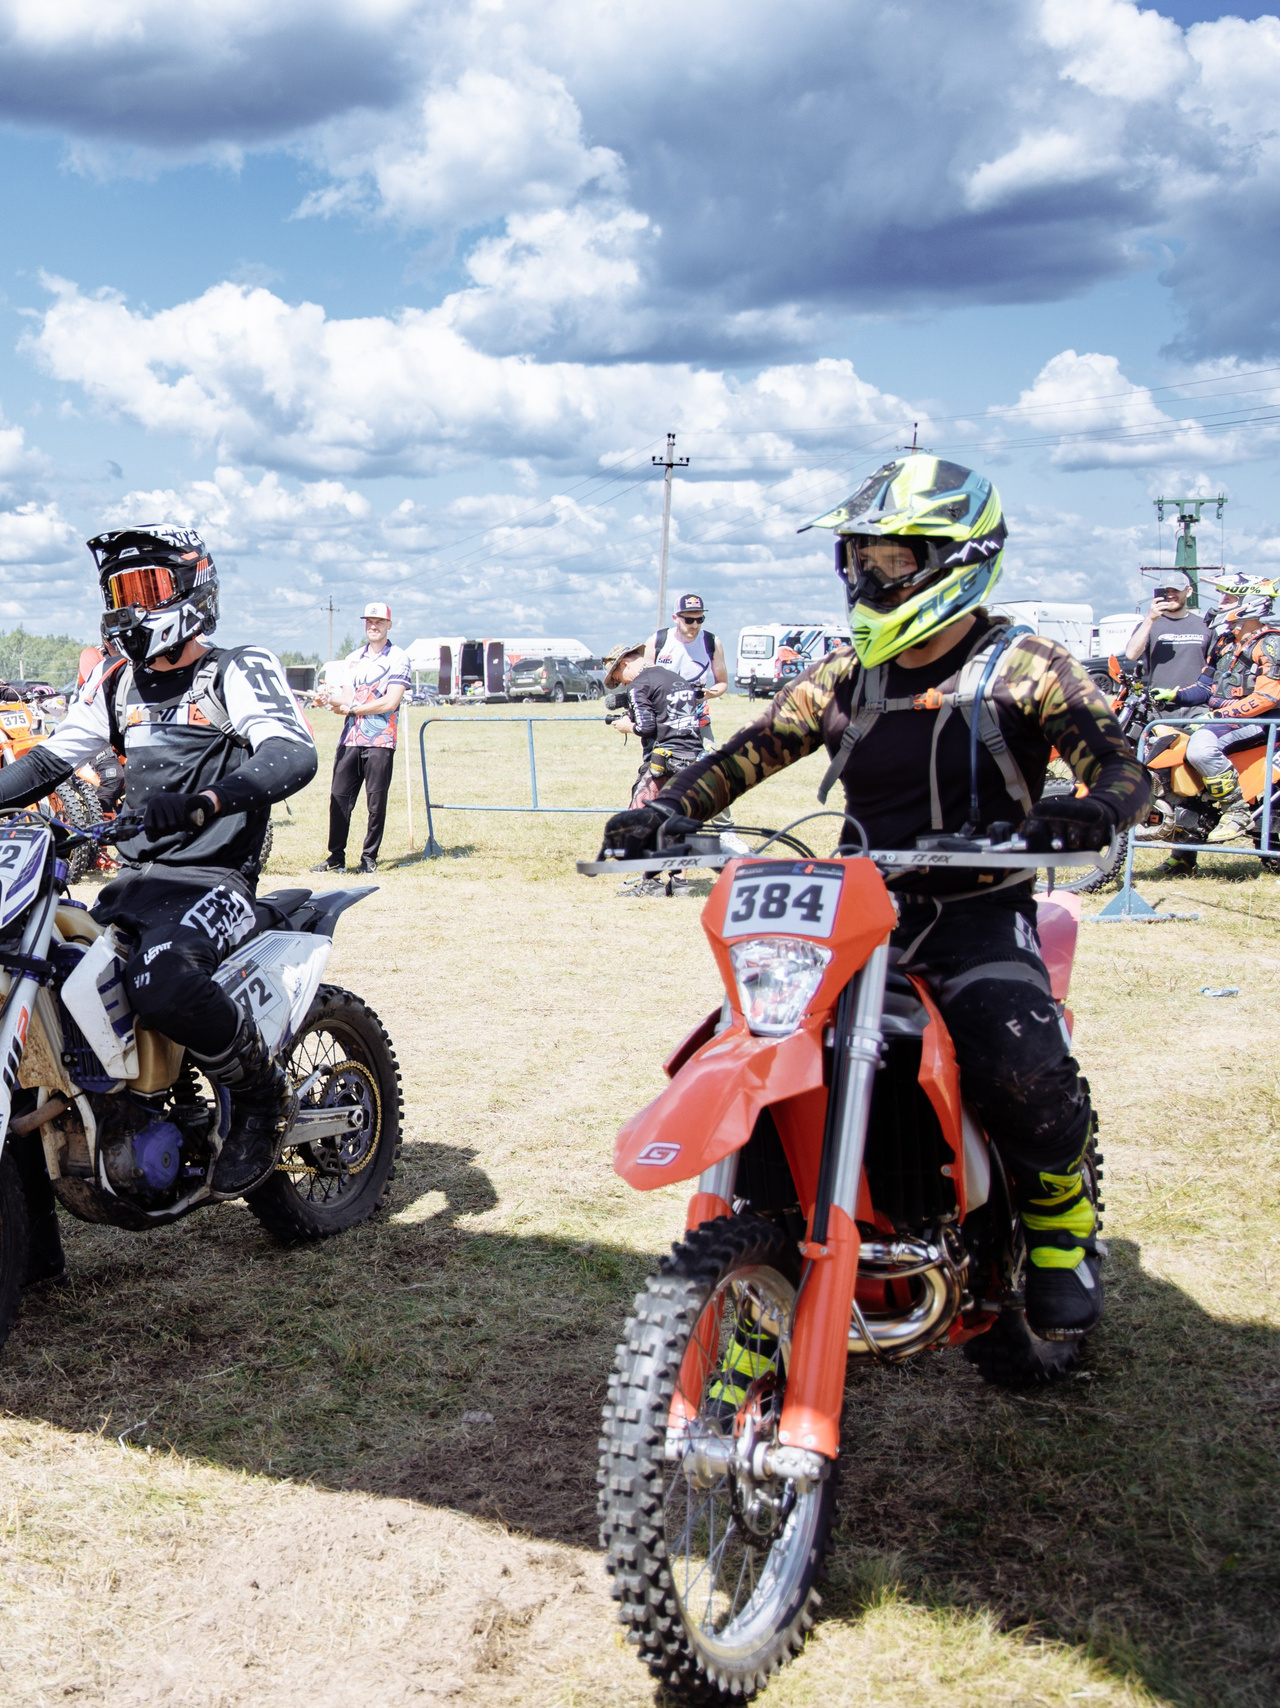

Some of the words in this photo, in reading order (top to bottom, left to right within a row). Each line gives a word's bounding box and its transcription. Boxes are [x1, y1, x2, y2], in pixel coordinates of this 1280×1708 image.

[3, 714, 26, 727] 375
[730, 883, 825, 924] 384
[143, 940, 173, 966] LEATT
[233, 976, 273, 1016] 72
